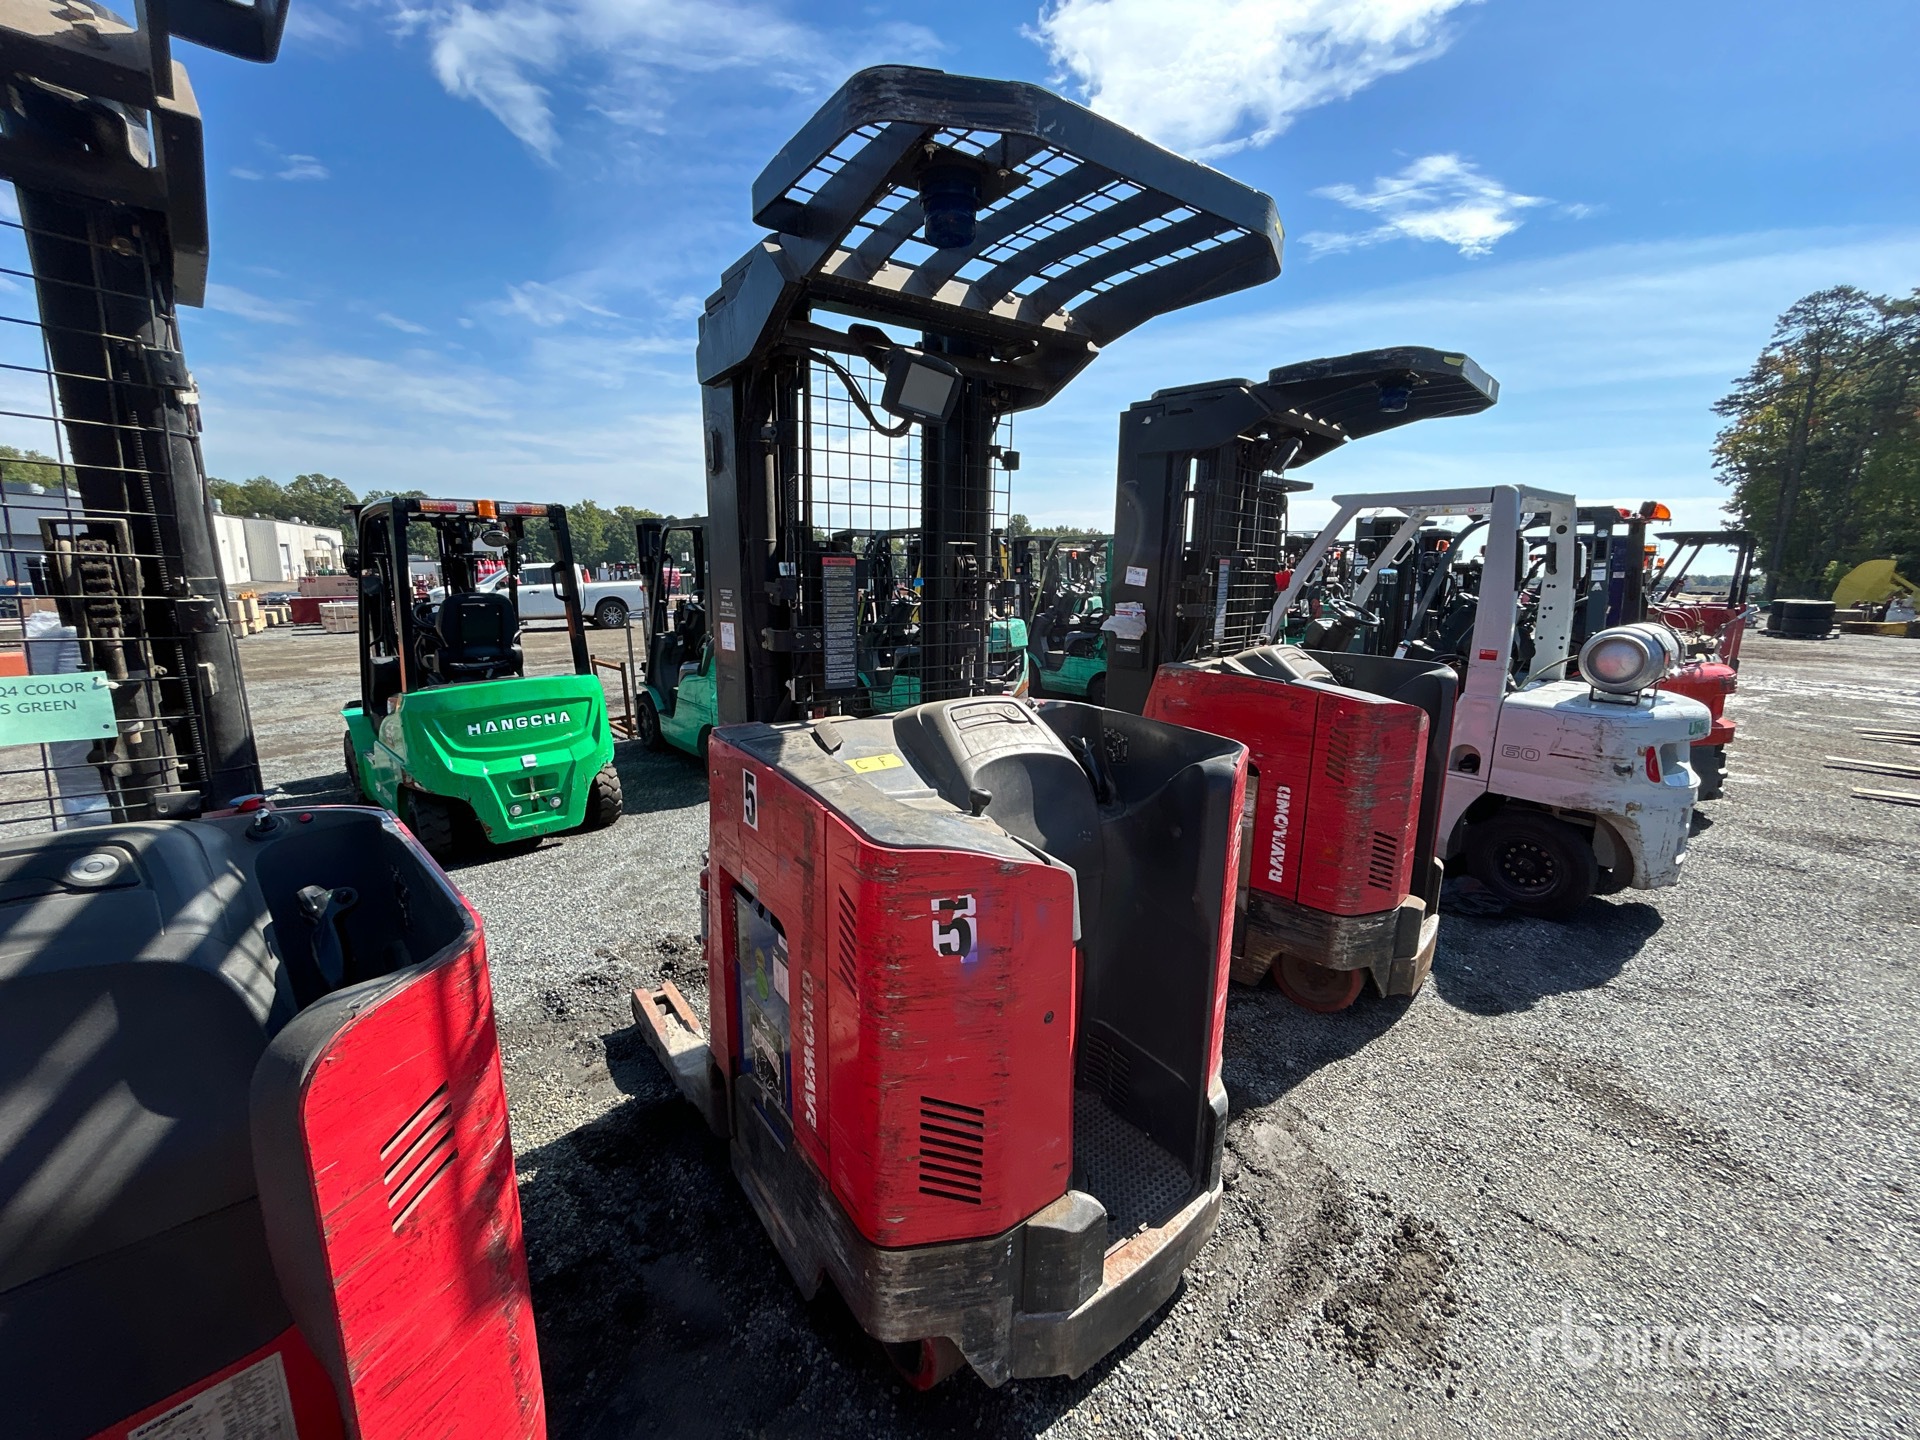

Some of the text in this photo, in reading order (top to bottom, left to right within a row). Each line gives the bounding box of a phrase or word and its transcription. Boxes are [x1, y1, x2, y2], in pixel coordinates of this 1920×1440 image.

[17, 699, 77, 714] GREEN
[24, 682, 86, 696] COLOR
[467, 711, 571, 736] HANGCHA
[744, 771, 757, 826] 5
[1268, 785, 1291, 884] RAYMOND
[938, 897, 972, 959] 5
